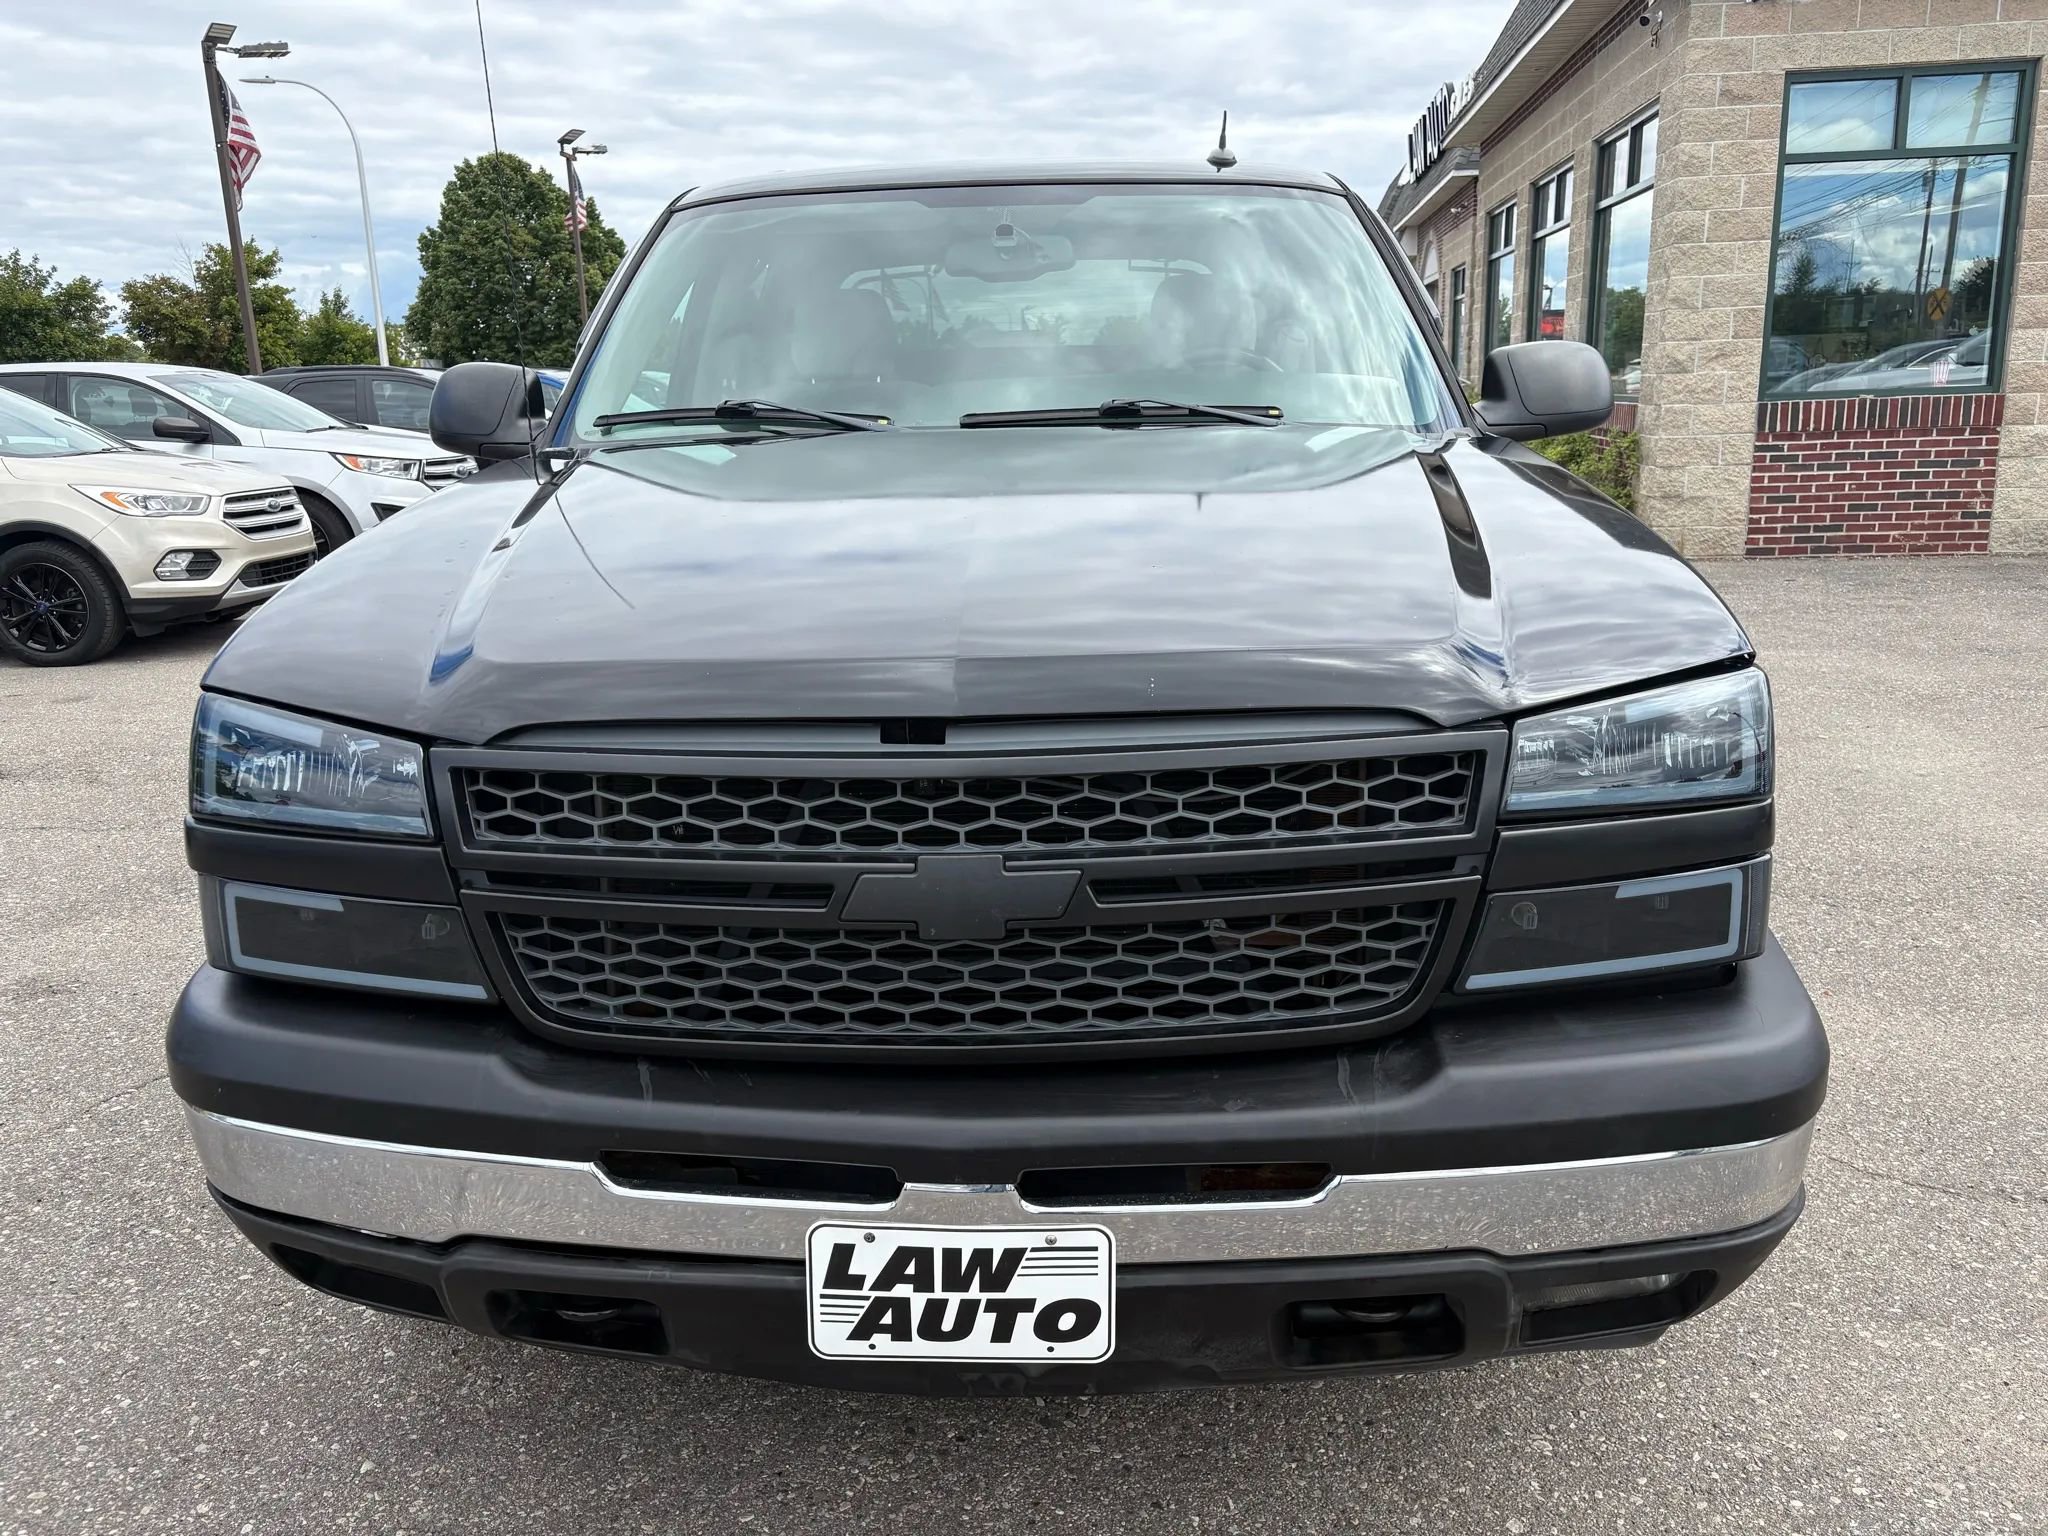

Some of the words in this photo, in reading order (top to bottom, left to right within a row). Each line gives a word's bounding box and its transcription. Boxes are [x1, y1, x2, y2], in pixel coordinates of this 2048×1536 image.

[1407, 113, 1428, 184] LAW
[1426, 81, 1451, 166] AUTO
[822, 1243, 1028, 1293] LAW
[846, 1296, 1102, 1343] AUTO
